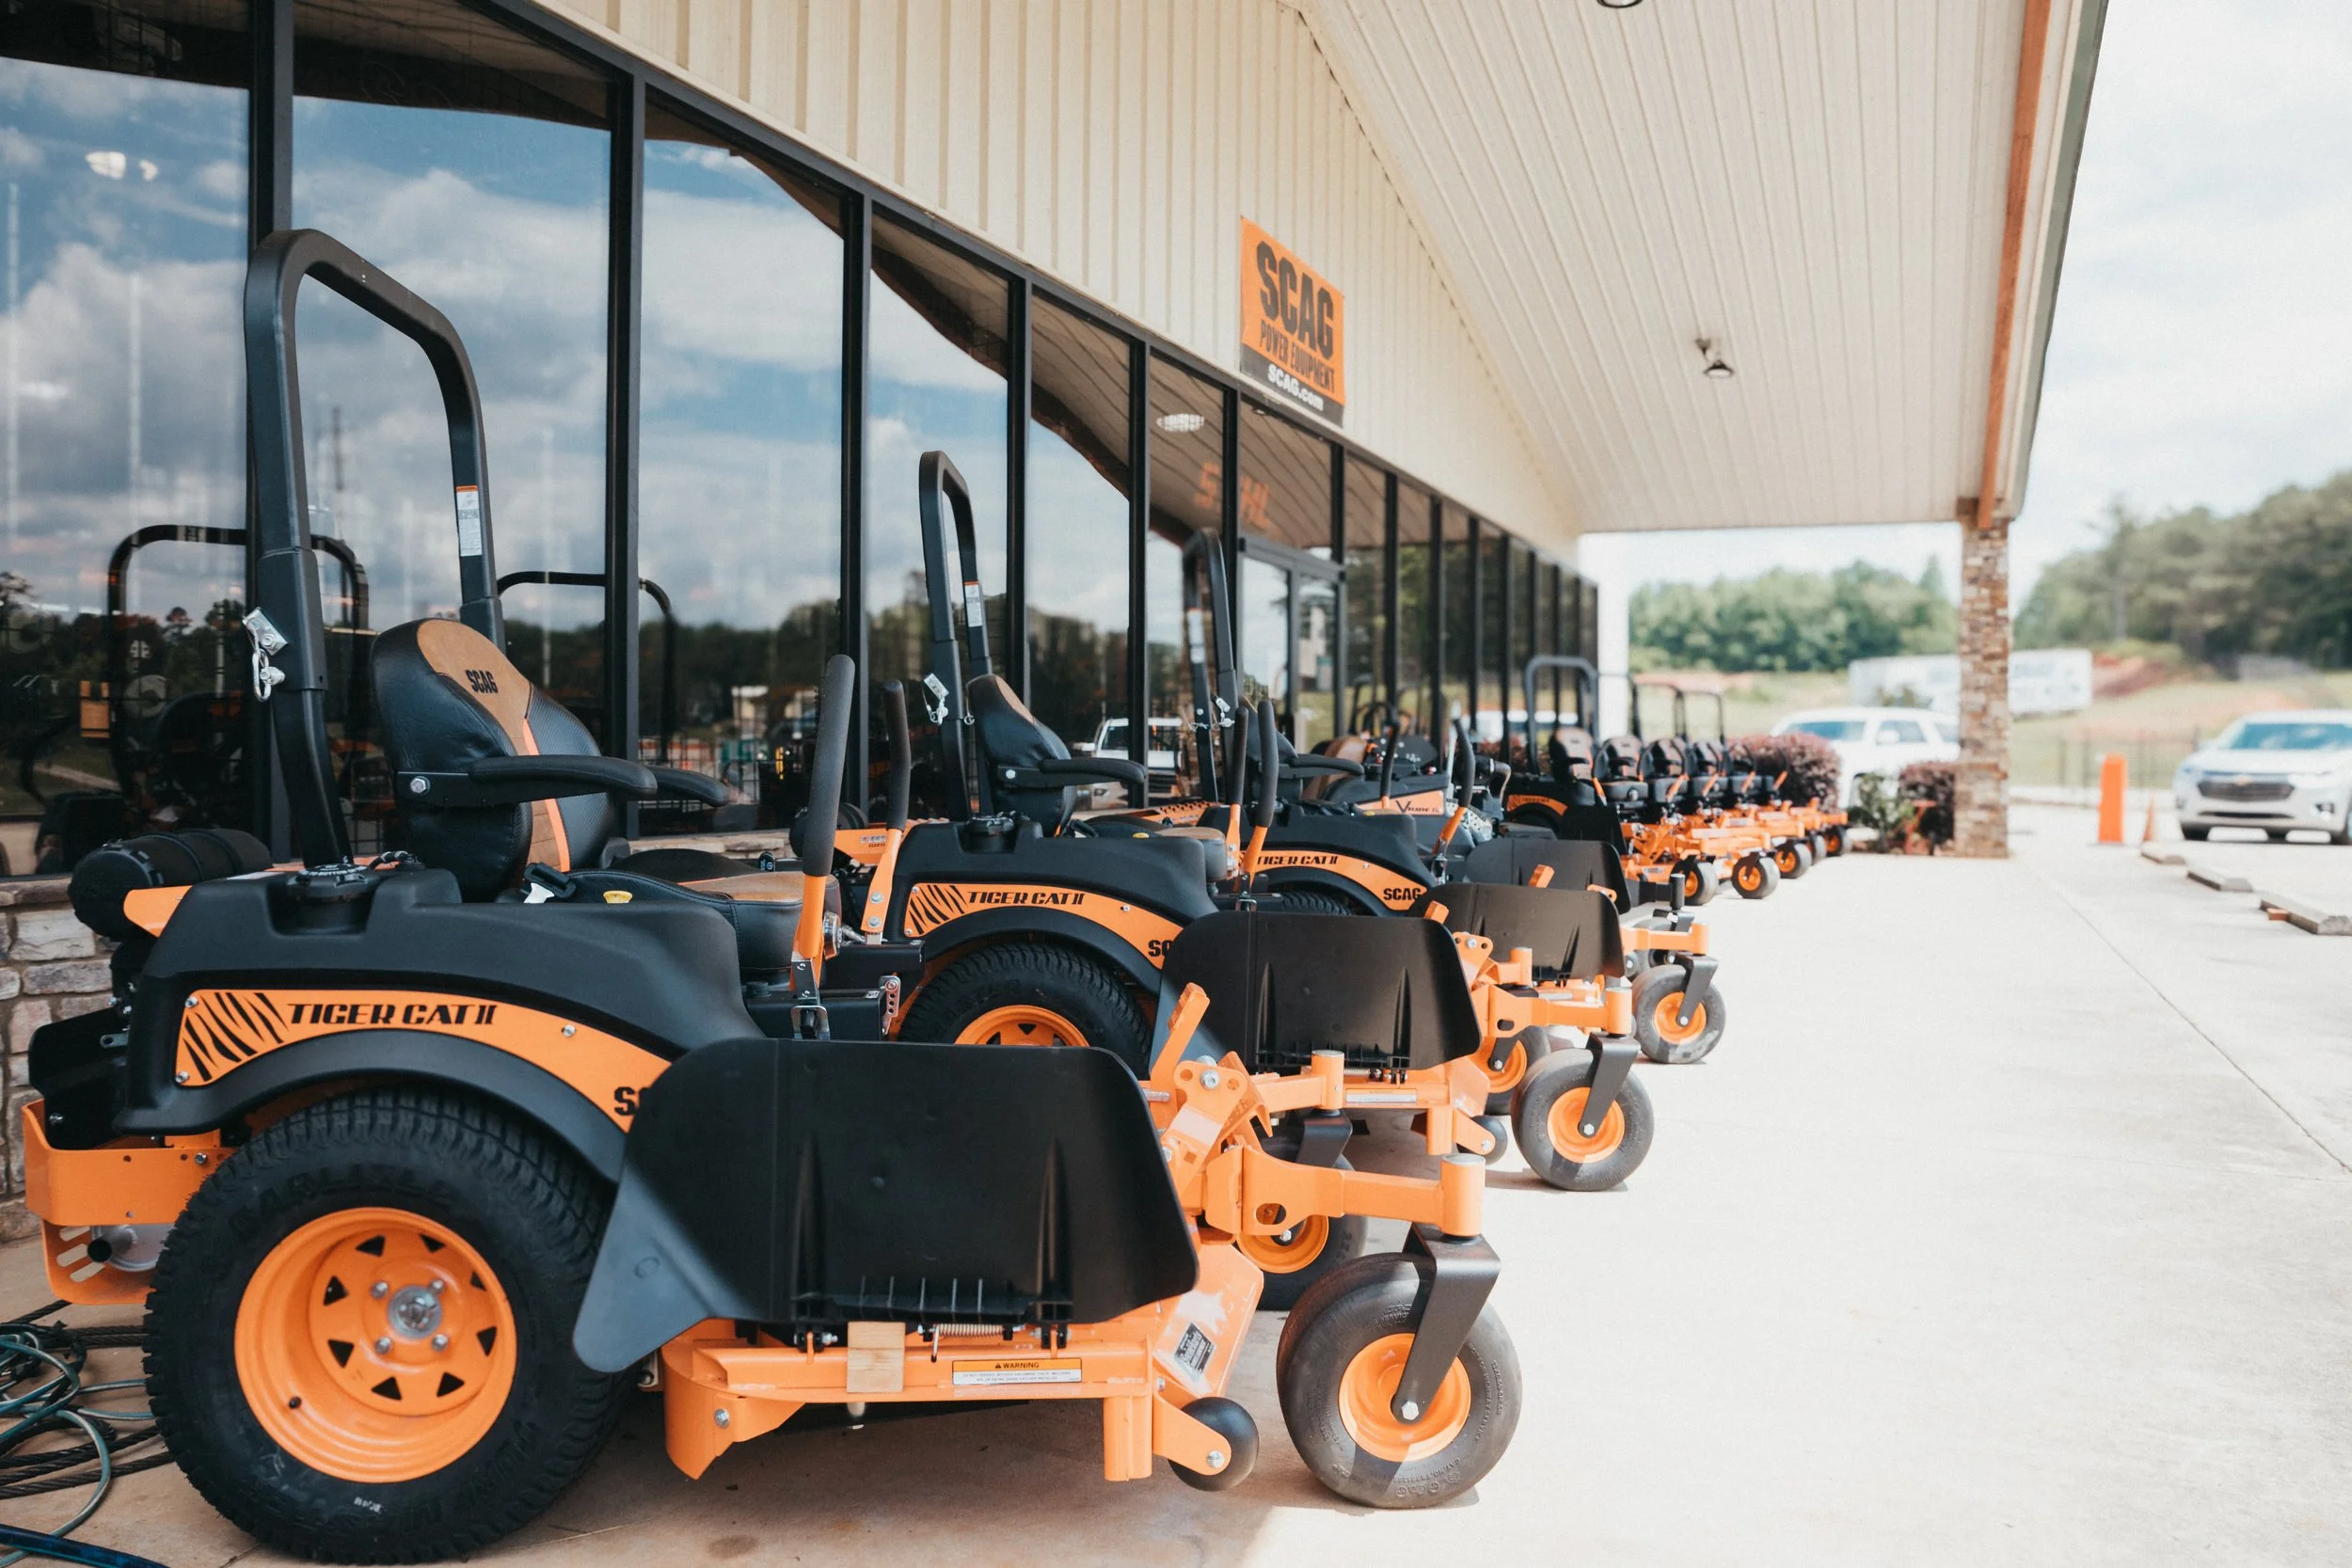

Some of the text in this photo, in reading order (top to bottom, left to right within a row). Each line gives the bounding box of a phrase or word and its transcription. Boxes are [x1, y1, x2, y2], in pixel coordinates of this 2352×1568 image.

[1256, 241, 1333, 360] SCAG
[1259, 317, 1335, 394] POWER EQUIPMENT
[1267, 364, 1325, 411] SCAG.com
[465, 669, 499, 693] SCAG
[1299, 856, 1331, 865] CAT
[967, 892, 1086, 905] TIGER CAT II
[1383, 887, 1422, 901] SCAG
[287, 1003, 498, 1026] TIGER CAT II
[613, 1085, 649, 1117] S
[1002, 1361, 1040, 1370] WARNING
